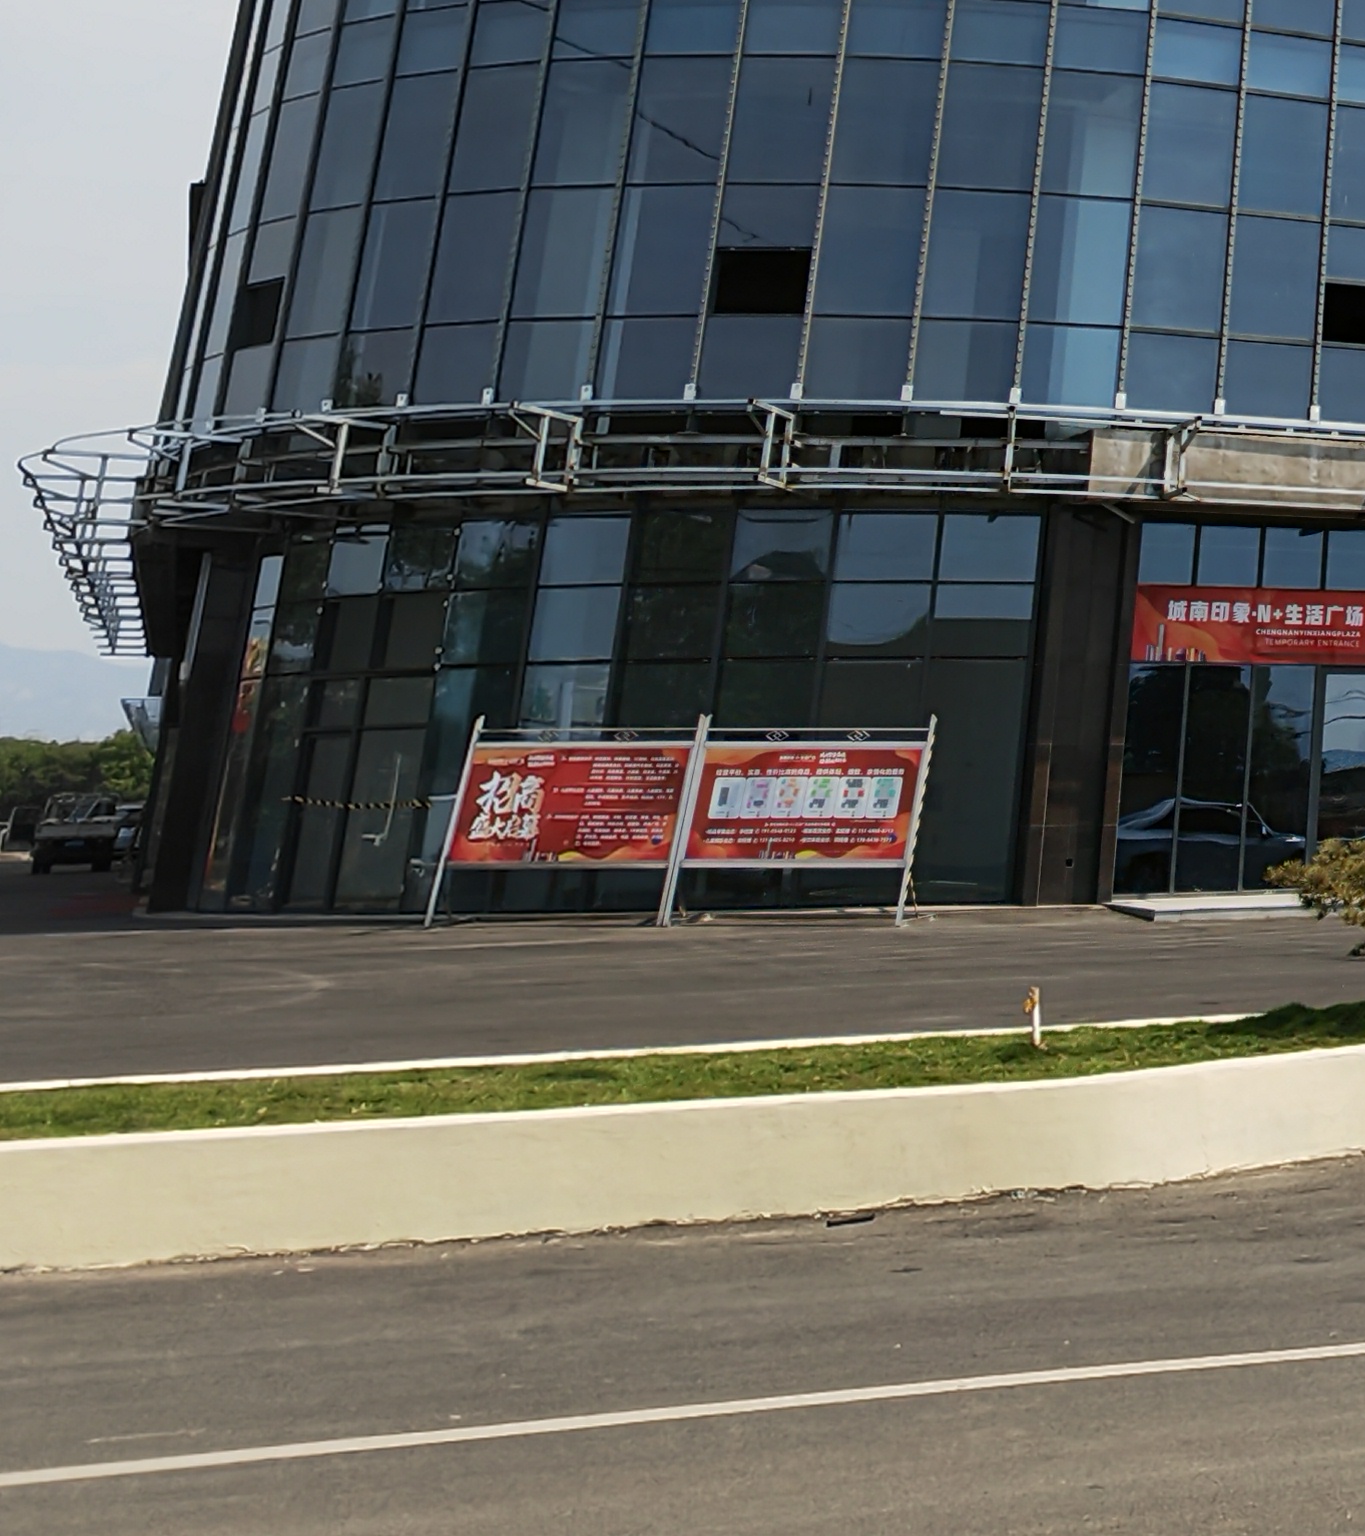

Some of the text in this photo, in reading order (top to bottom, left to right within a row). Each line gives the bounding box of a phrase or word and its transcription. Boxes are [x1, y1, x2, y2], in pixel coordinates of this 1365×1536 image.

[1265, 637, 1360, 648] TEMPORARY ENTRANCE
[475, 770, 546, 815] 招商
